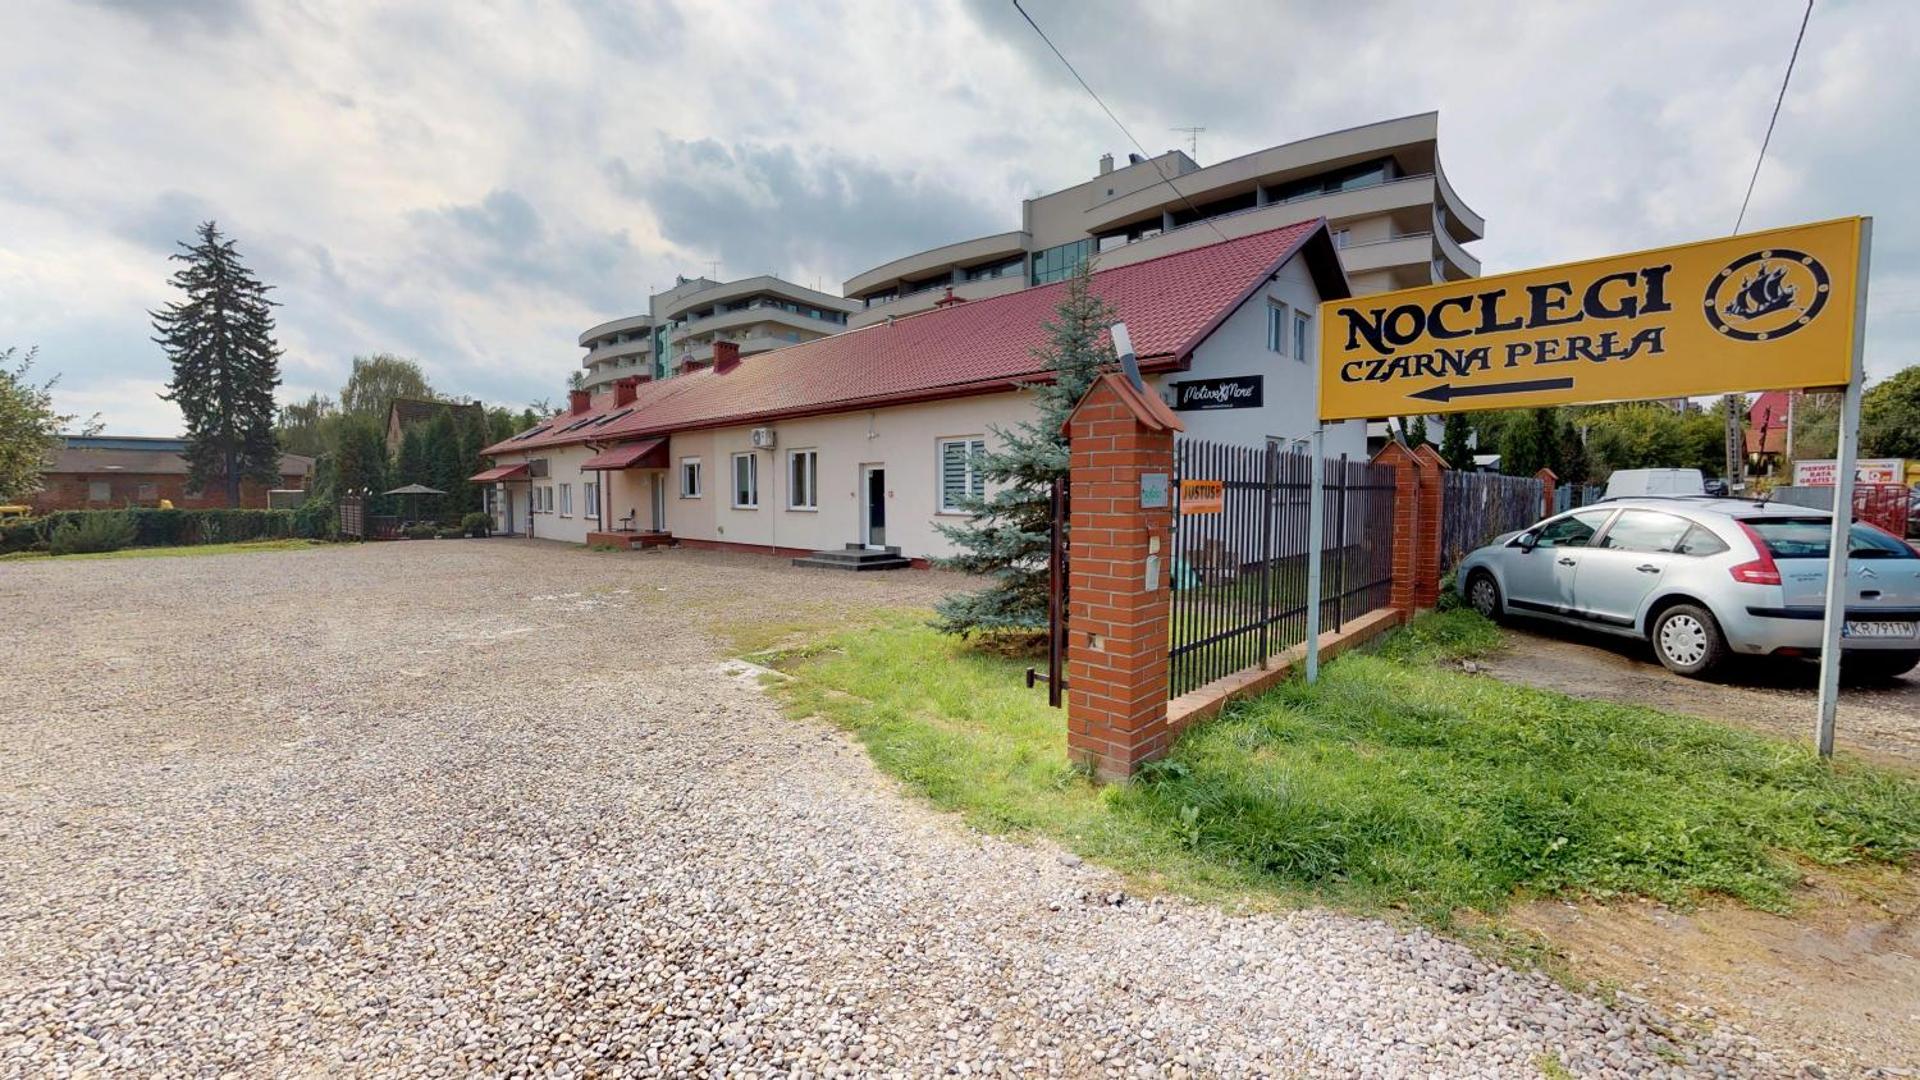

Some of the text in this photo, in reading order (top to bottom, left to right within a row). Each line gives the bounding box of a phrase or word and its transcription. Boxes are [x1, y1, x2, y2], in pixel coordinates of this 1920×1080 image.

[1337, 264, 1672, 355] NOCLEGI
[1341, 326, 1666, 383] CZARNA PERŁA
[1183, 484, 1216, 500] JUSTUS
